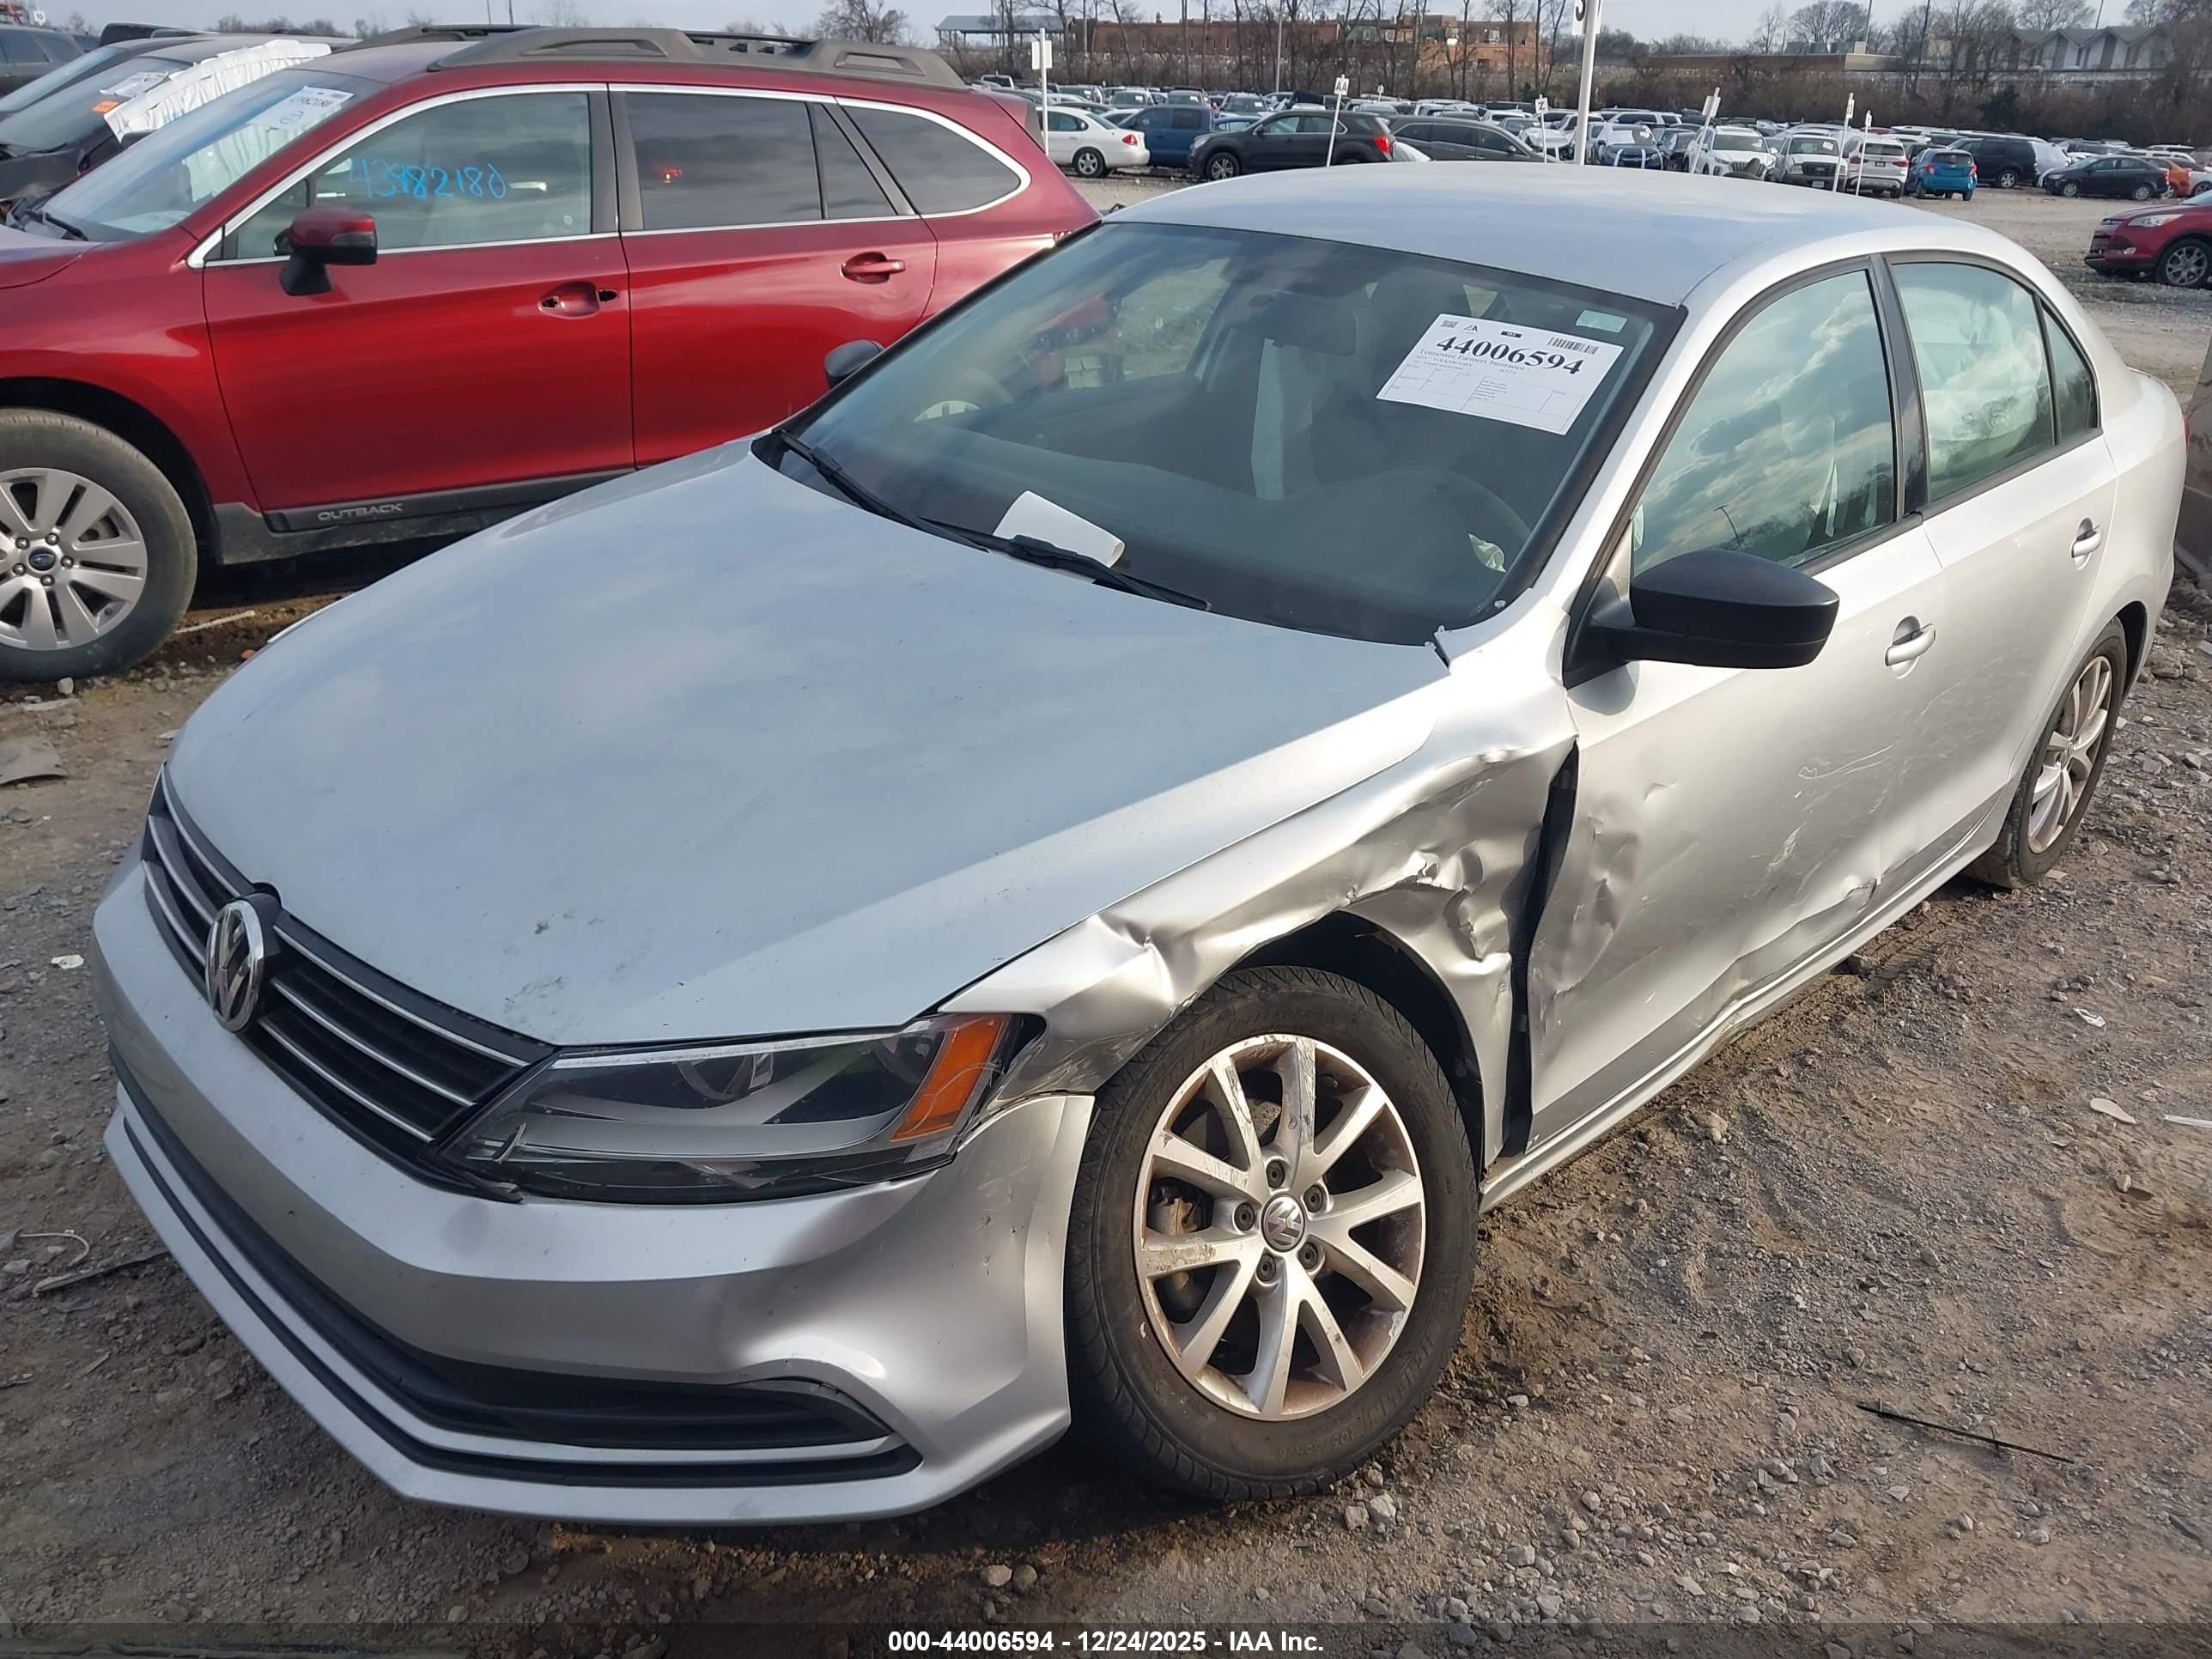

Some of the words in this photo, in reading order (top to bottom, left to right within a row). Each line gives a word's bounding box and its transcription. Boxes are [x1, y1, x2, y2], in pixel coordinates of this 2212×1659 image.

[1419, 349, 1457, 360] Tennessee
[1458, 354, 1487, 364] Farmers
[1489, 360, 1527, 372] Insurance
[1436, 336, 1585, 374] 44006594
[318, 502, 404, 520] OUTBACK
